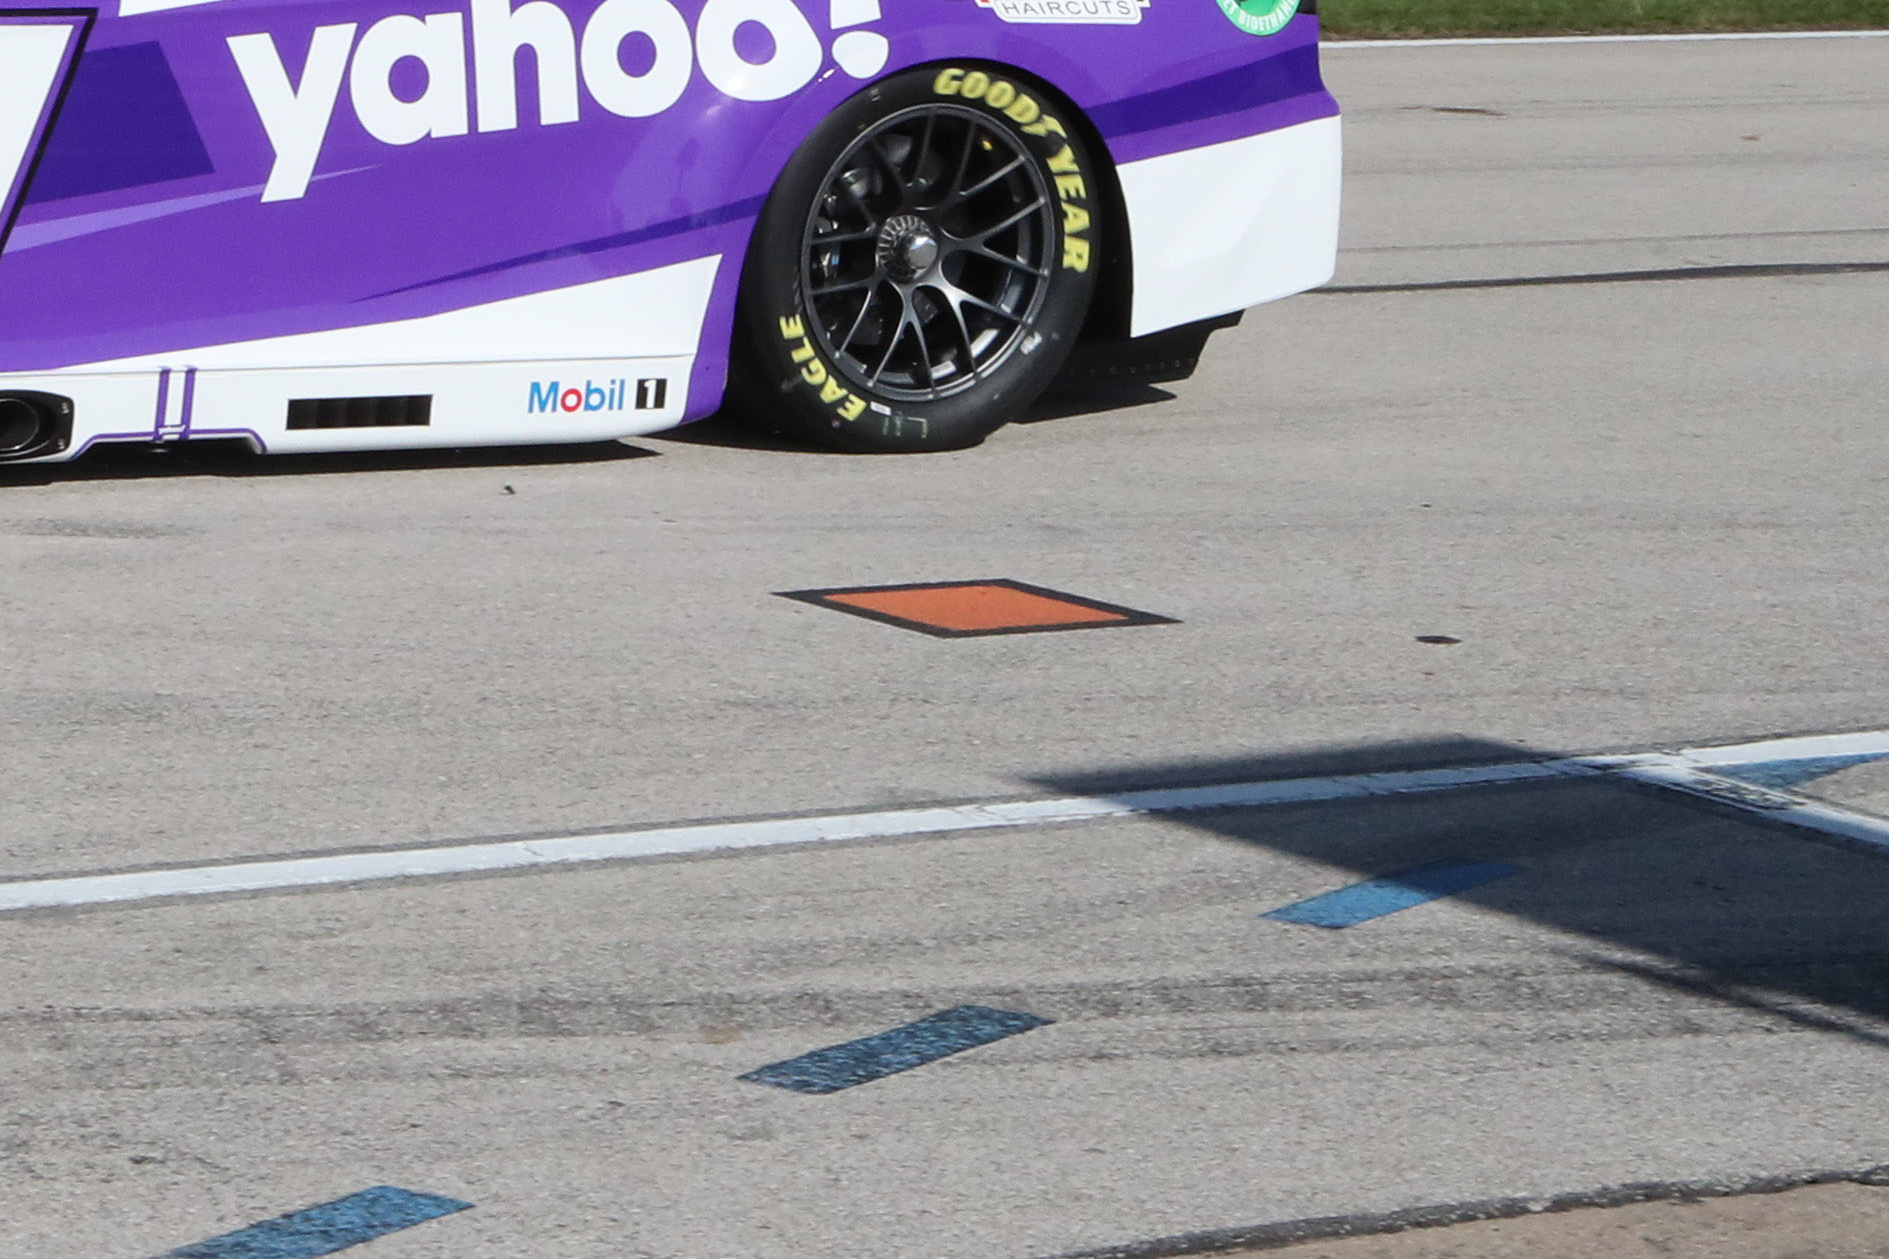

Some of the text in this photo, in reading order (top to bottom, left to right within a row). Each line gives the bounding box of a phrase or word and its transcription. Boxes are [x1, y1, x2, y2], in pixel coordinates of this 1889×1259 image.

[1002, 0, 1132, 17] HAIRCUTS
[779, 314, 867, 422] EAGLE
[528, 379, 625, 413] Mobil
